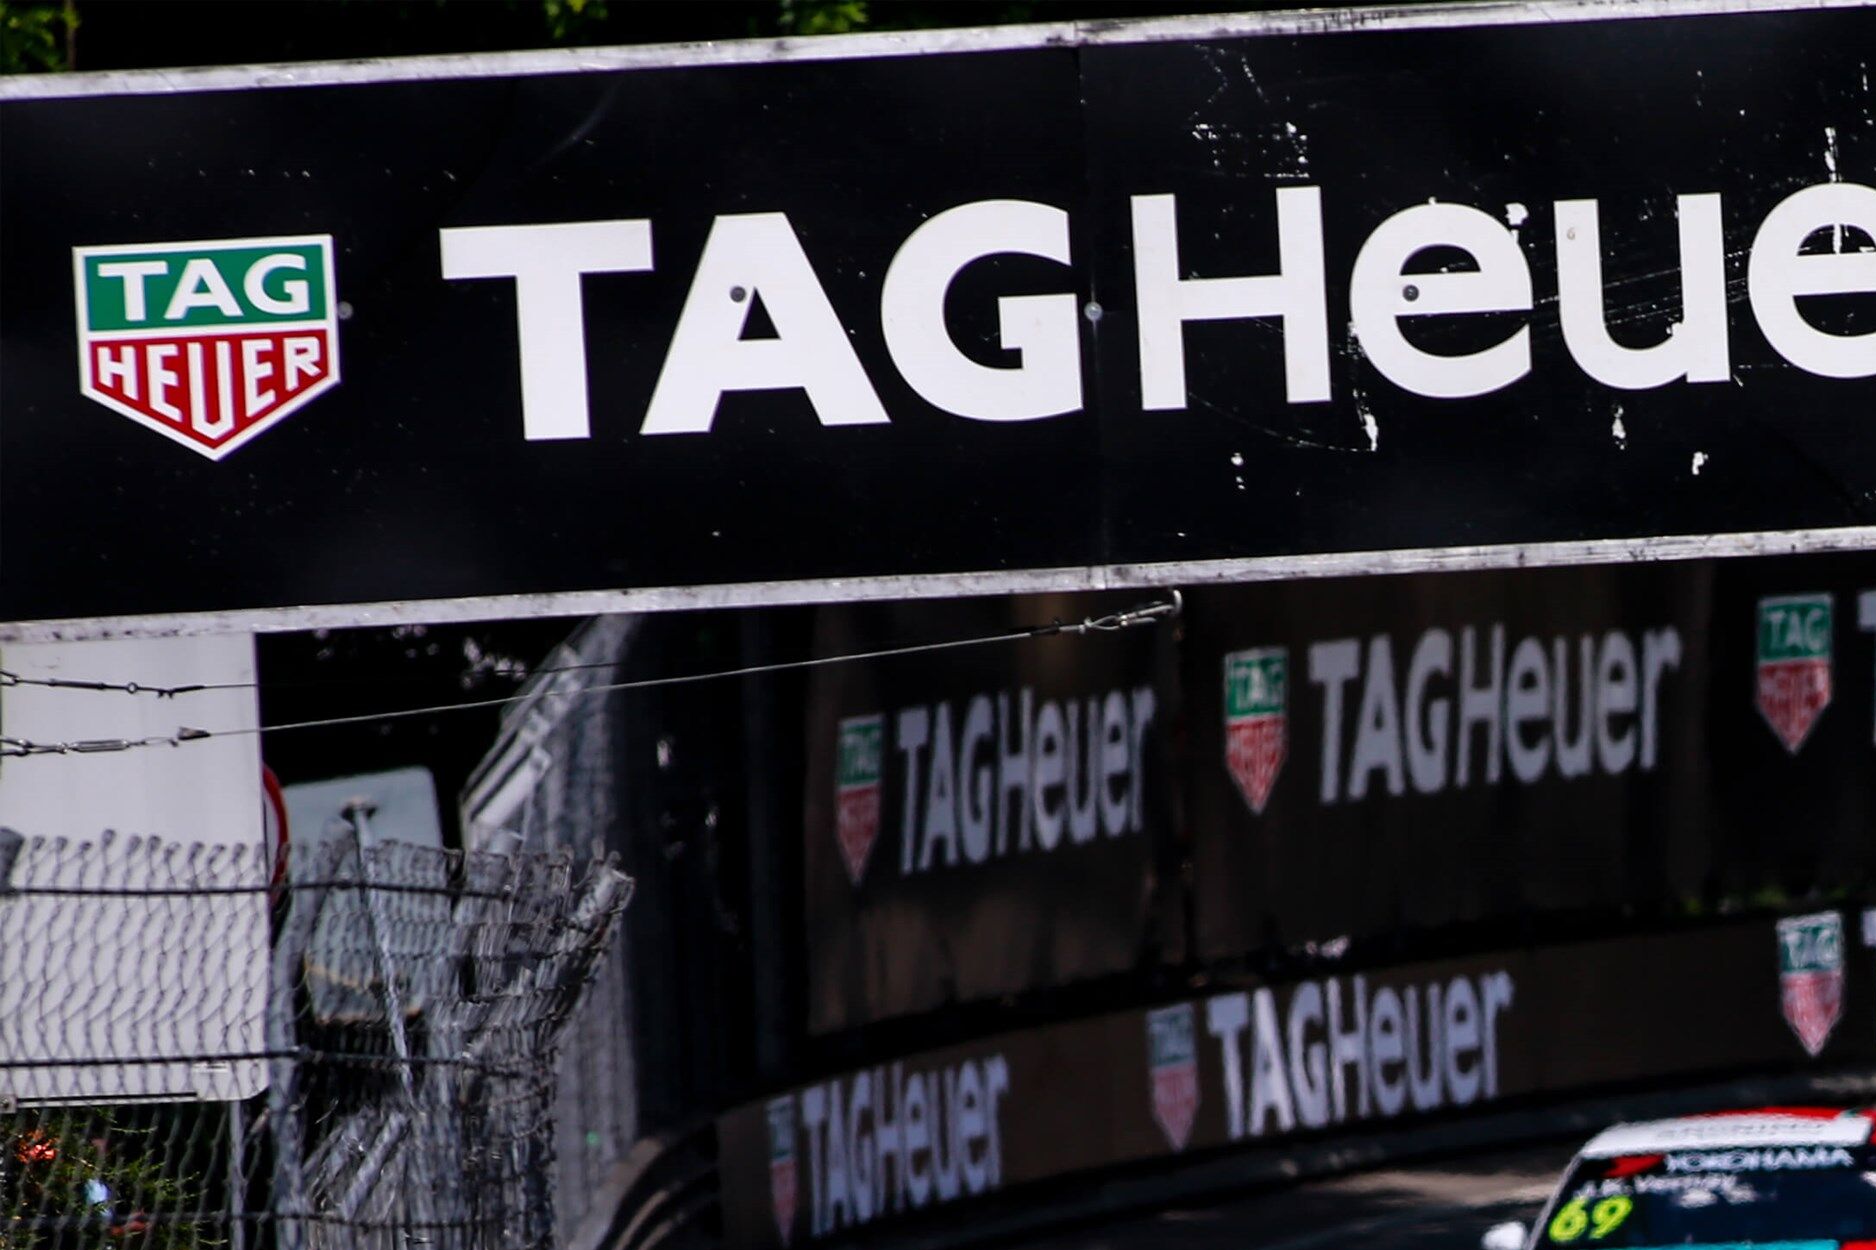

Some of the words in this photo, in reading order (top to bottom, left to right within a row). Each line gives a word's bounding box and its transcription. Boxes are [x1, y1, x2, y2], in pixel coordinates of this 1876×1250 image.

[97, 252, 311, 322] TAG
[96, 335, 322, 441] HEUER
[1665, 1147, 1853, 1171] YOKOHAMA
[1549, 1195, 1632, 1242] 69
